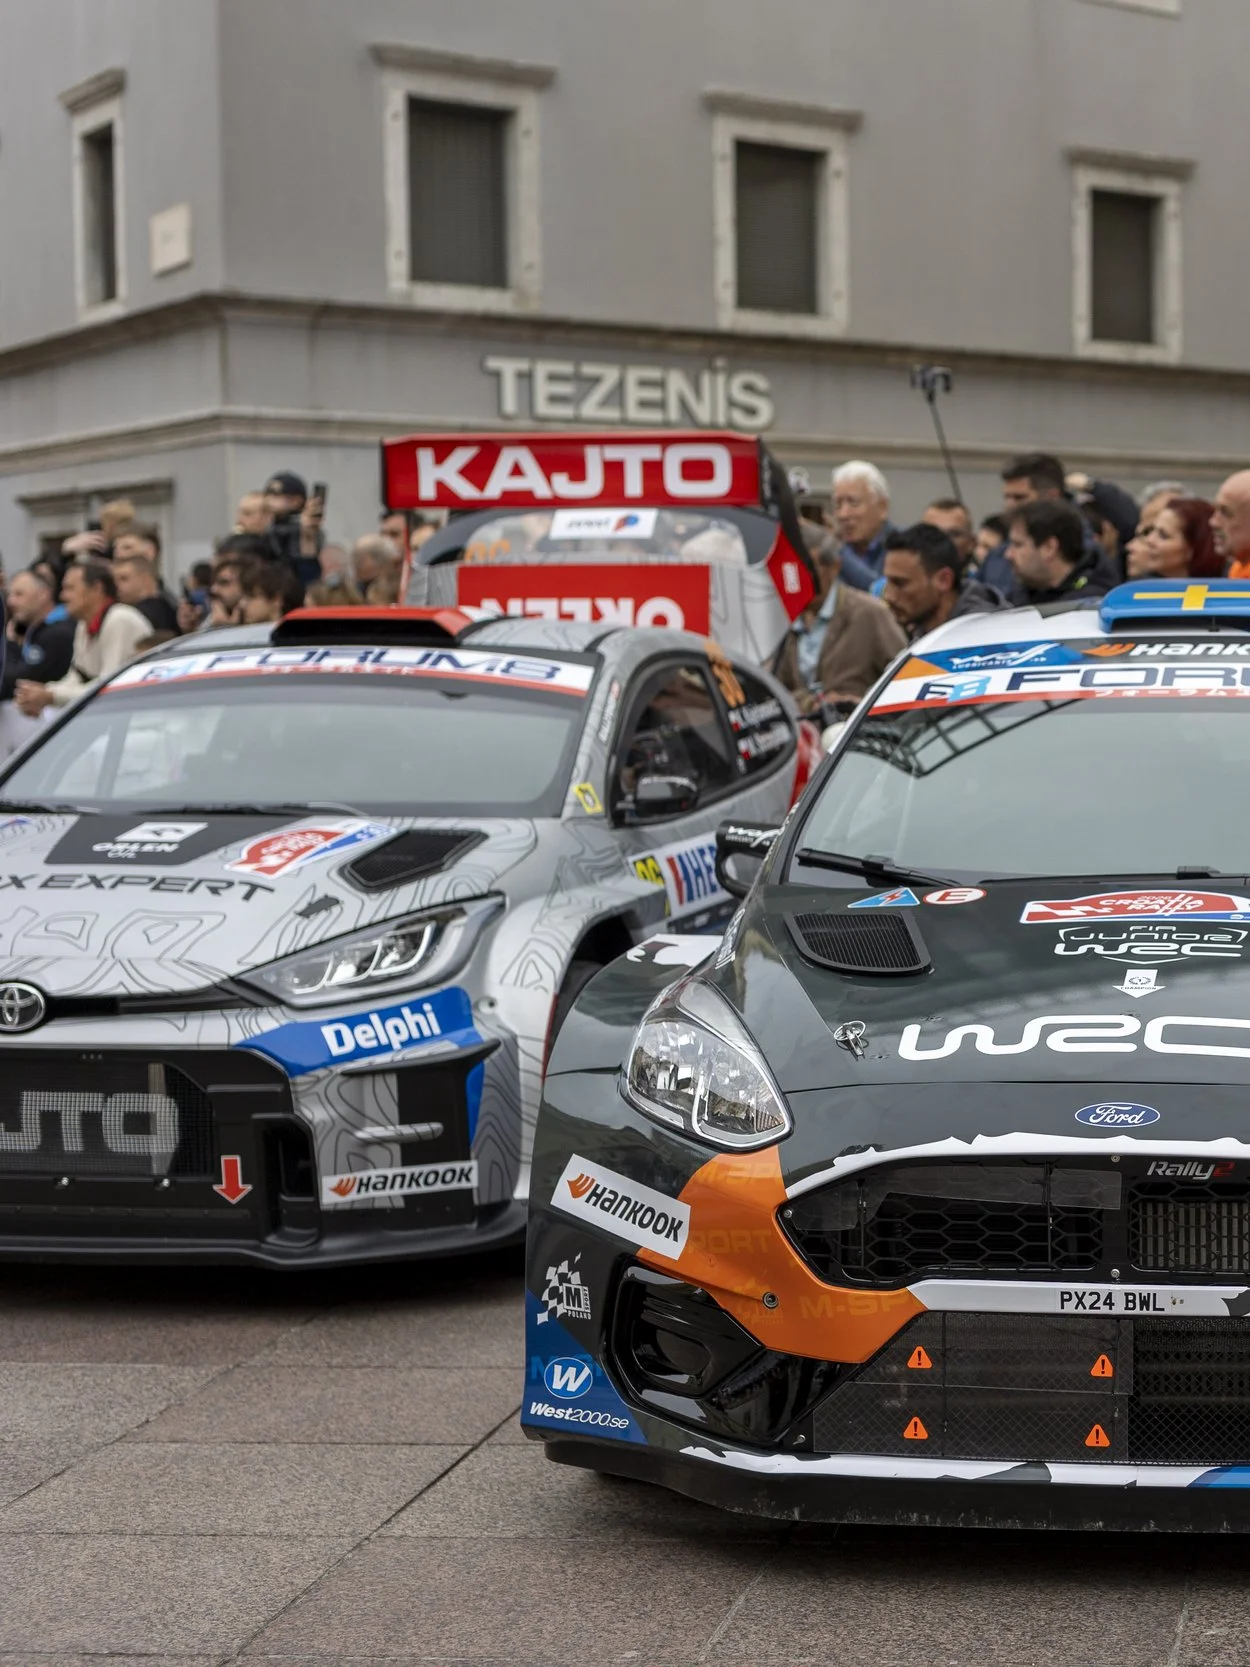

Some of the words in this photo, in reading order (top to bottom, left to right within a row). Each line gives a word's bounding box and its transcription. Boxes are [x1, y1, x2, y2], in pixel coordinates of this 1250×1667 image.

[416, 443, 732, 500] KAJTO
[38, 874, 275, 902] EXPERT
[1070, 932, 1233, 942] JUNIOR
[1054, 942, 1243, 957] WRC
[320, 1003, 441, 1056] Delphi
[1089, 1104, 1146, 1124] Ford
[1147, 1160, 1235, 1180] Rally2
[1060, 1291, 1115, 1310] PX24
[1124, 1292, 1165, 1312] BWL
[567, 1309, 592, 1320] POLAND
[552, 1364, 591, 1392] W
[529, 1402, 629, 1429] West2000.se
